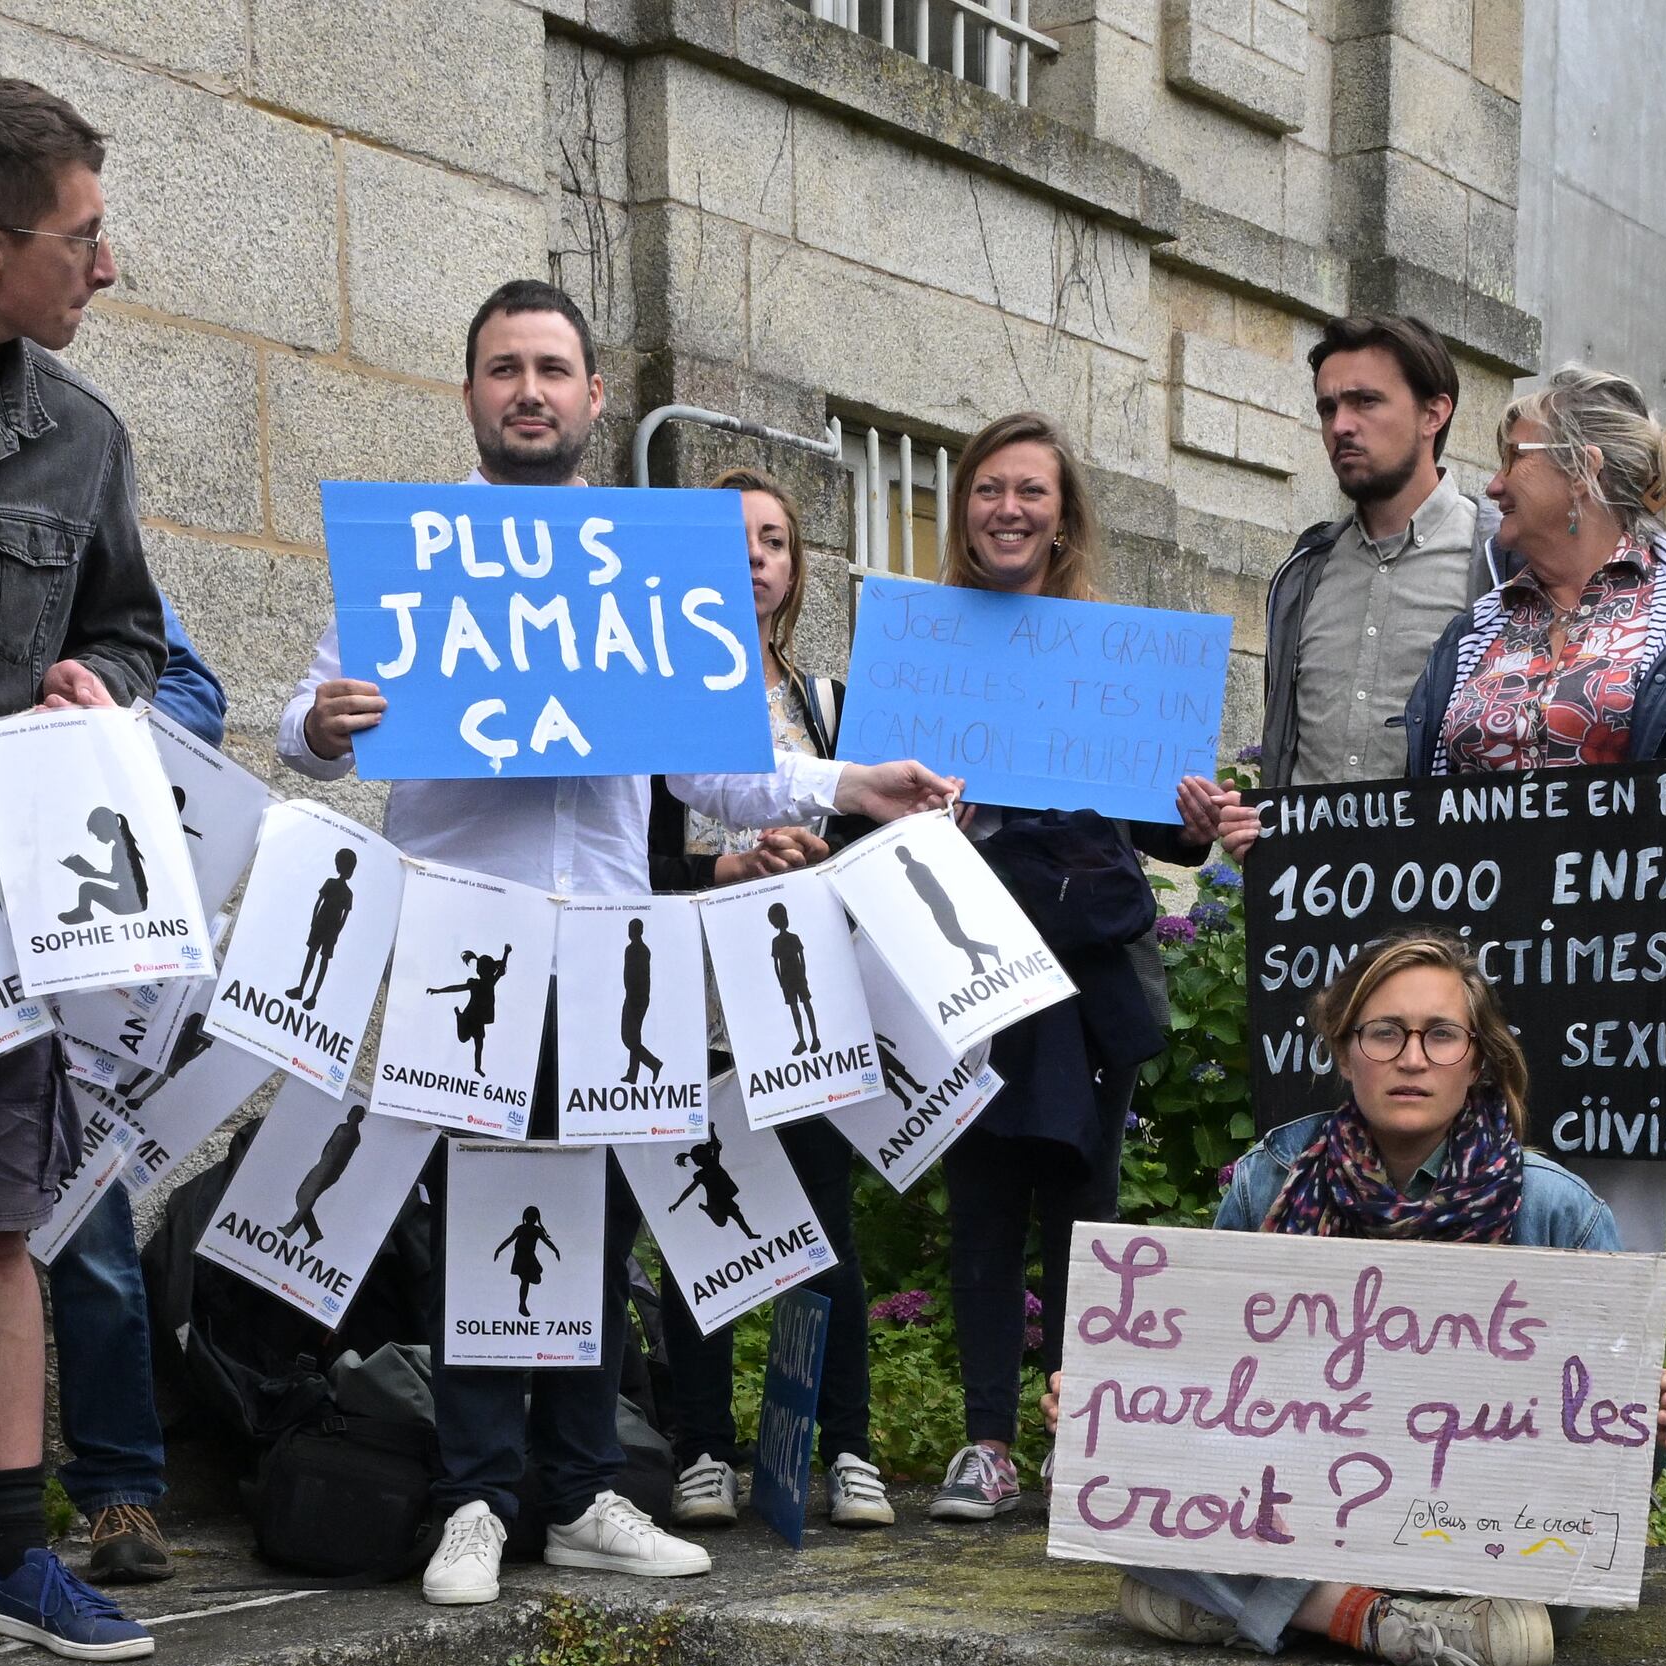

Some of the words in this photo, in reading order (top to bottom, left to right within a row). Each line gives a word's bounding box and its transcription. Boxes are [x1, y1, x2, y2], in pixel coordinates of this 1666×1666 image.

[410, 509, 625, 586] PLUS
[1009, 613, 1085, 658] AUX
[459, 694, 592, 775] ÇA
[1159, 691, 1210, 726] UN
[1257, 790, 1417, 841] CHAQUE
[1437, 772, 1570, 825] ANNÉE
[1587, 777, 1636, 816] EN
[31, 925, 115, 954] SOPHIE
[121, 918, 189, 943] 10ANS
[220, 979, 355, 1066] ANONYME
[936, 950, 1053, 1026] ANONYME
[382, 1063, 479, 1098] SANDRINE
[483, 1086, 527, 1107] 6ANS
[566, 1083, 702, 1113] ANONYME
[749, 1043, 873, 1098] ANONYME
[216, 1211, 353, 1298] ANONYME
[692, 1221, 819, 1306] ANONYME
[455, 1320, 541, 1336] SOLENNE
[546, 1320, 593, 1336] 7ANS
[1076, 1235, 1188, 1350] Les
[1243, 1264, 1549, 1392] enfants
[1069, 1354, 1375, 1458] parlent
[1405, 1397, 1541, 1490] qui
[1559, 1353, 1651, 1449] les
[1077, 1464, 1297, 1546] croit
[1327, 1451, 1393, 1549] ?
[1476, 1517, 1503, 1532] on
[1514, 1503, 1536, 1530] te
